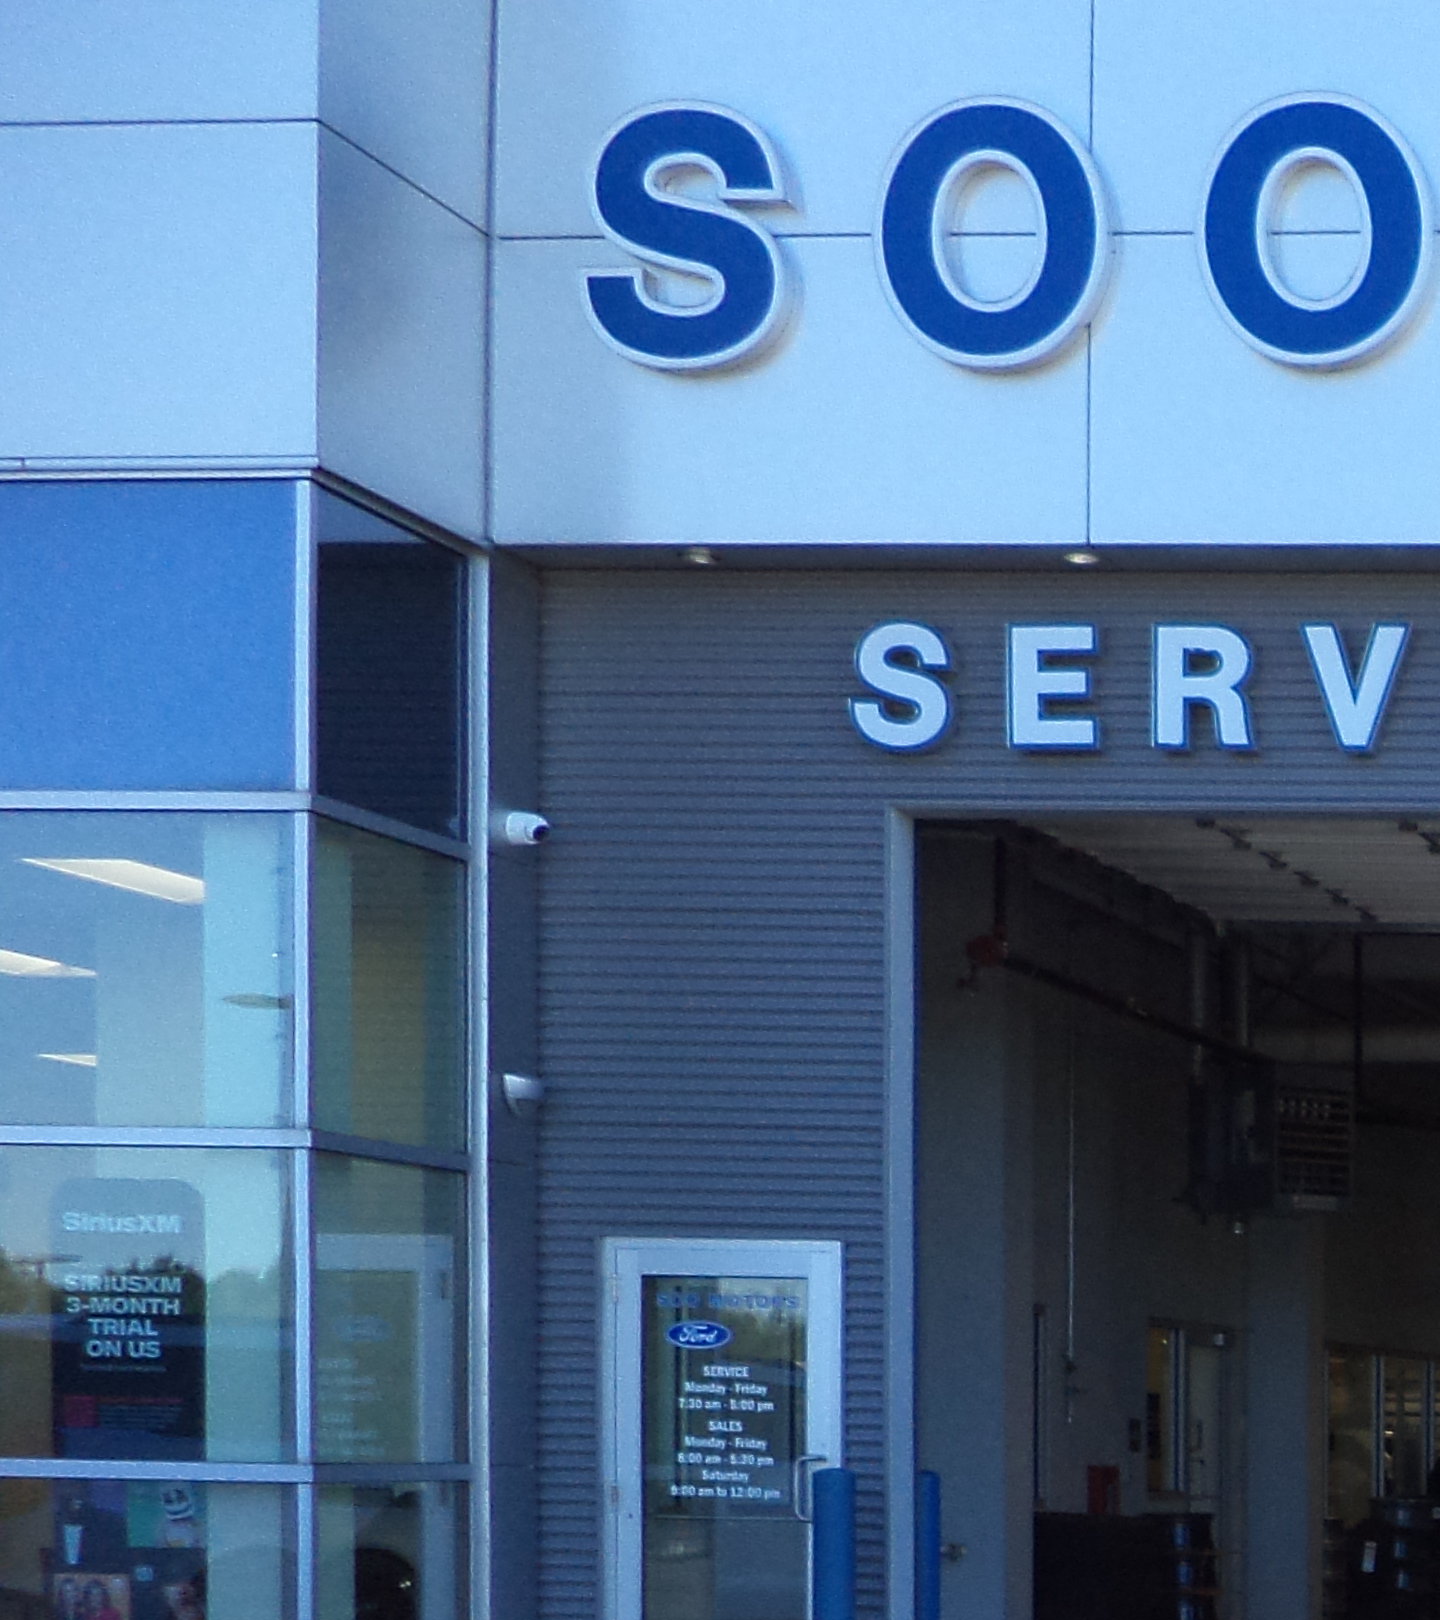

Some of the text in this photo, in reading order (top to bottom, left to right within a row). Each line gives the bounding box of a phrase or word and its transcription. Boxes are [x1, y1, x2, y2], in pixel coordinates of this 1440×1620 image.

[583, 95, 1428, 364] SOO
[62, 1212, 182, 1233] SiriusXM
[63, 1273, 182, 1293] SIRIUSXM
[66, 1297, 181, 1315] 3-MONTH
[87, 1318, 159, 1336] TRIAL
[86, 1339, 162, 1359] ON US
[703, 1365, 749, 1378] SERVICE
[684, 1382, 726, 1395] Monday
[735, 1383, 768, 1396] Friday
[757, 1401, 775, 1412] pm
[709, 1420, 743, 1432] SALES
[684, 1436, 726, 1450] Monday
[735, 1437, 768, 1451] Friday
[702, 1469, 750, 1484] Saturday
